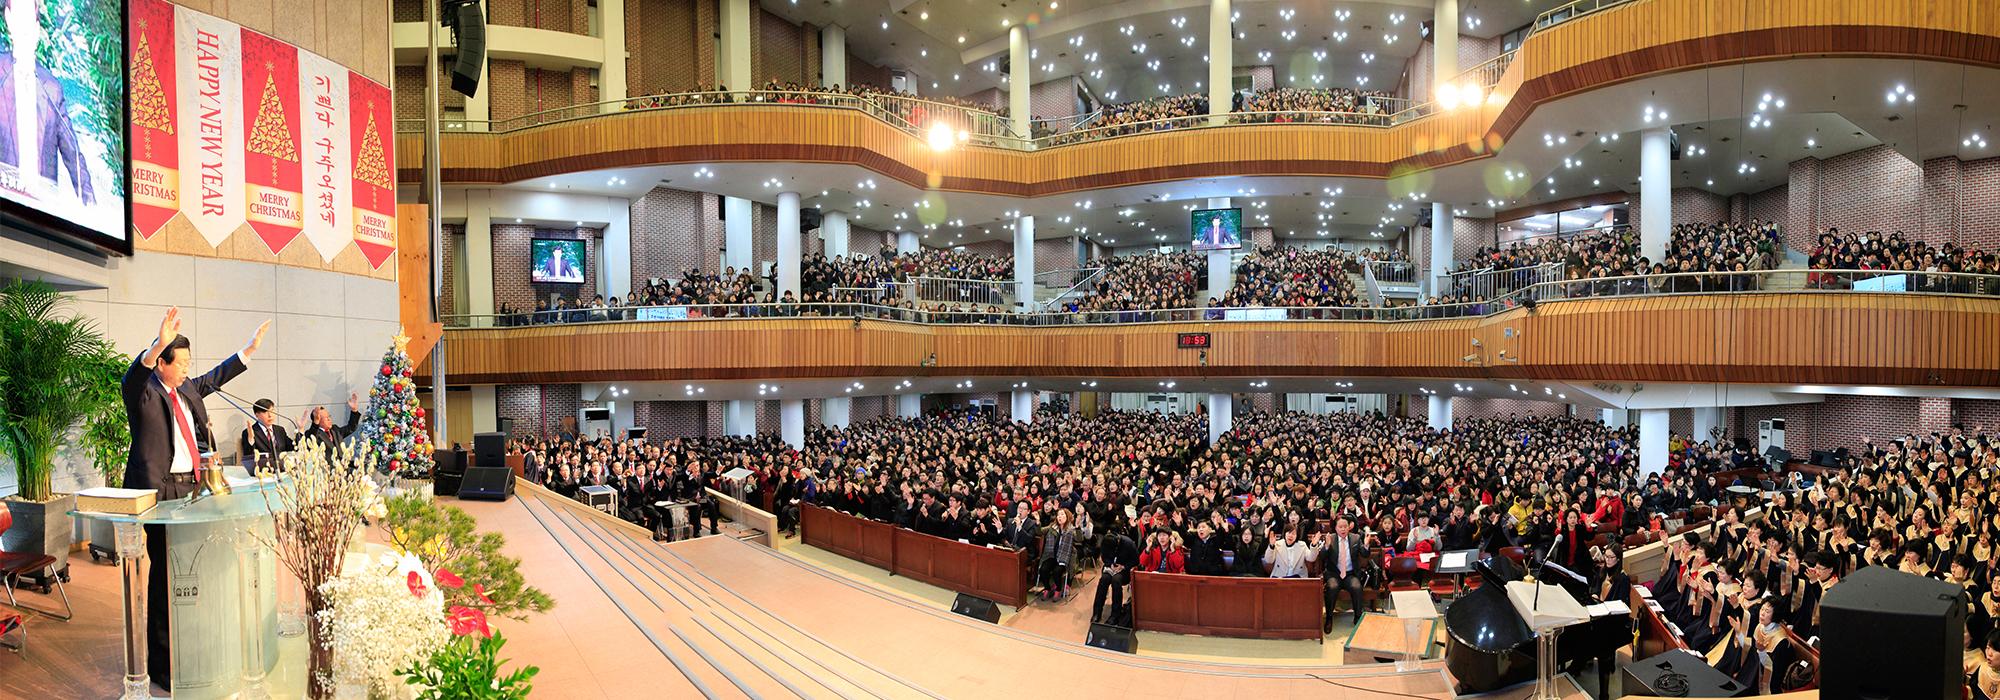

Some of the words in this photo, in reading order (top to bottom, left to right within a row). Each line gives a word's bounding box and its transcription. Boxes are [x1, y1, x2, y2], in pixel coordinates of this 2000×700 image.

[196, 28, 221, 104] HAPPY
[314, 75, 336, 129] 기쁘다
[200, 104, 223, 158] NEW
[132, 167, 164, 185] MERRY
[133, 182, 177, 202] RISTMAS
[201, 161, 225, 217] YEAR
[259, 192, 290, 207] MERRY
[249, 202, 301, 222] CHRISTMAS
[363, 214, 387, 229] MERRY
[355, 224, 395, 242] CHRISTMAS
